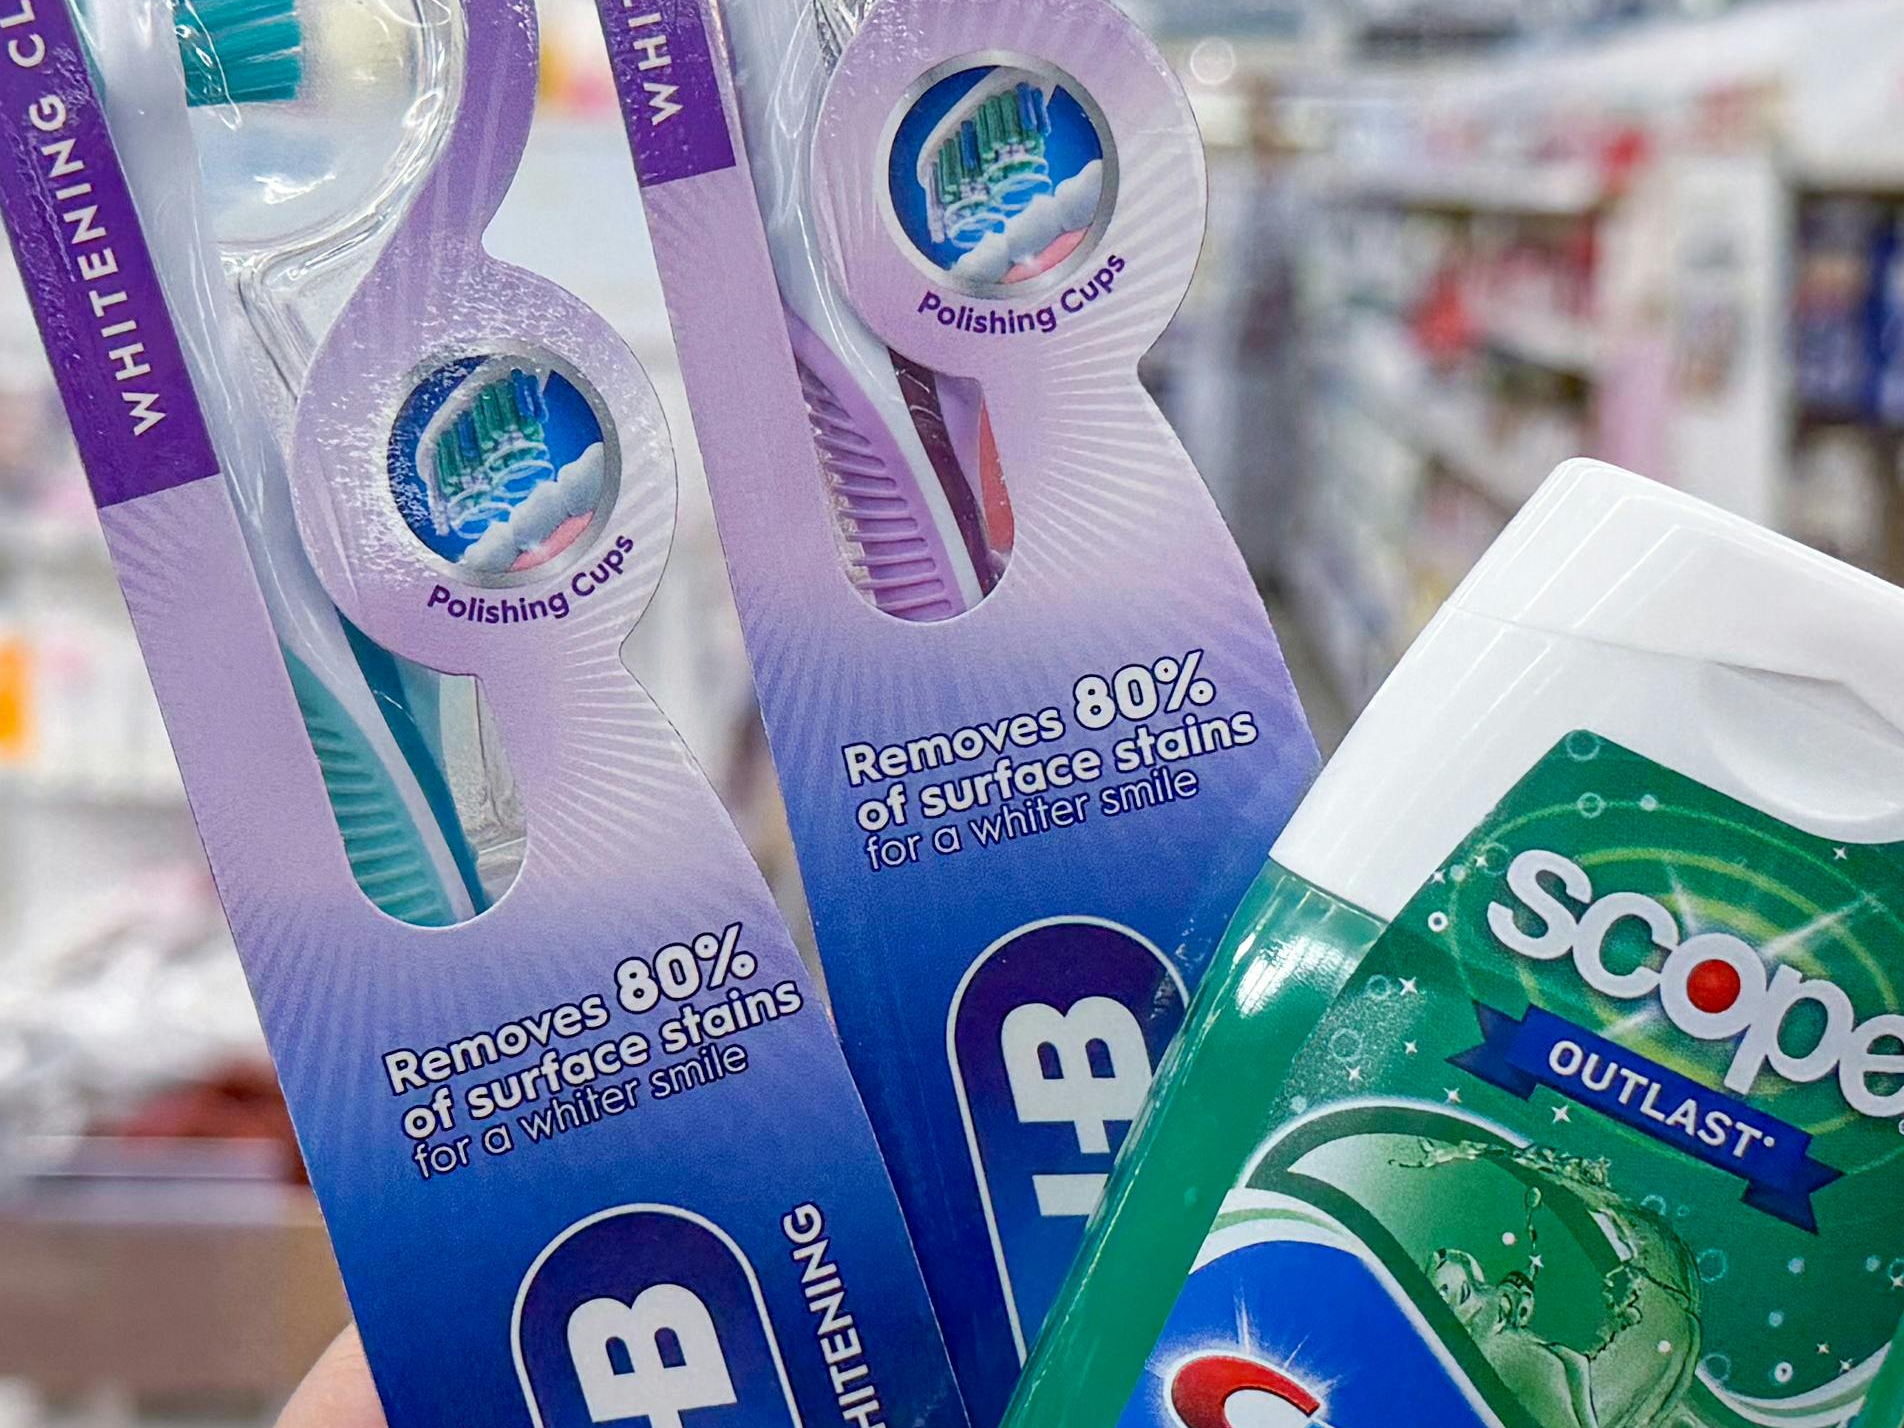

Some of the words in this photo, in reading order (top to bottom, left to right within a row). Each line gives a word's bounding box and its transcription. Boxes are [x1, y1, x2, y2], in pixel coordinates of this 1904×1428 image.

[30, 94, 167, 436] WHITENING
[917, 290, 1057, 334] Polishing
[1060, 252, 1126, 313] Cups
[427, 584, 569, 624] Polishing
[571, 534, 634, 597] Cups
[842, 707, 1065, 786] Removes
[1073, 649, 1215, 731] 80%
[857, 785, 908, 833] of
[922, 748, 1101, 819] surface
[1115, 711, 1258, 773] stains
[866, 833, 921, 871] for
[933, 824, 962, 855] a
[969, 791, 1090, 846] whiter
[1102, 767, 1200, 816] smile
[384, 994, 609, 1096] Removes
[615, 922, 758, 1013] 80%
[403, 1087, 454, 1140] of
[467, 1032, 651, 1119] surface
[660, 980, 803, 1056] stains
[414, 1135, 471, 1179] for
[482, 1123, 513, 1156] a
[520, 1078, 641, 1143] whiter
[651, 1042, 748, 1099] smile
[1547, 1039, 1764, 1160] OUTLAST
